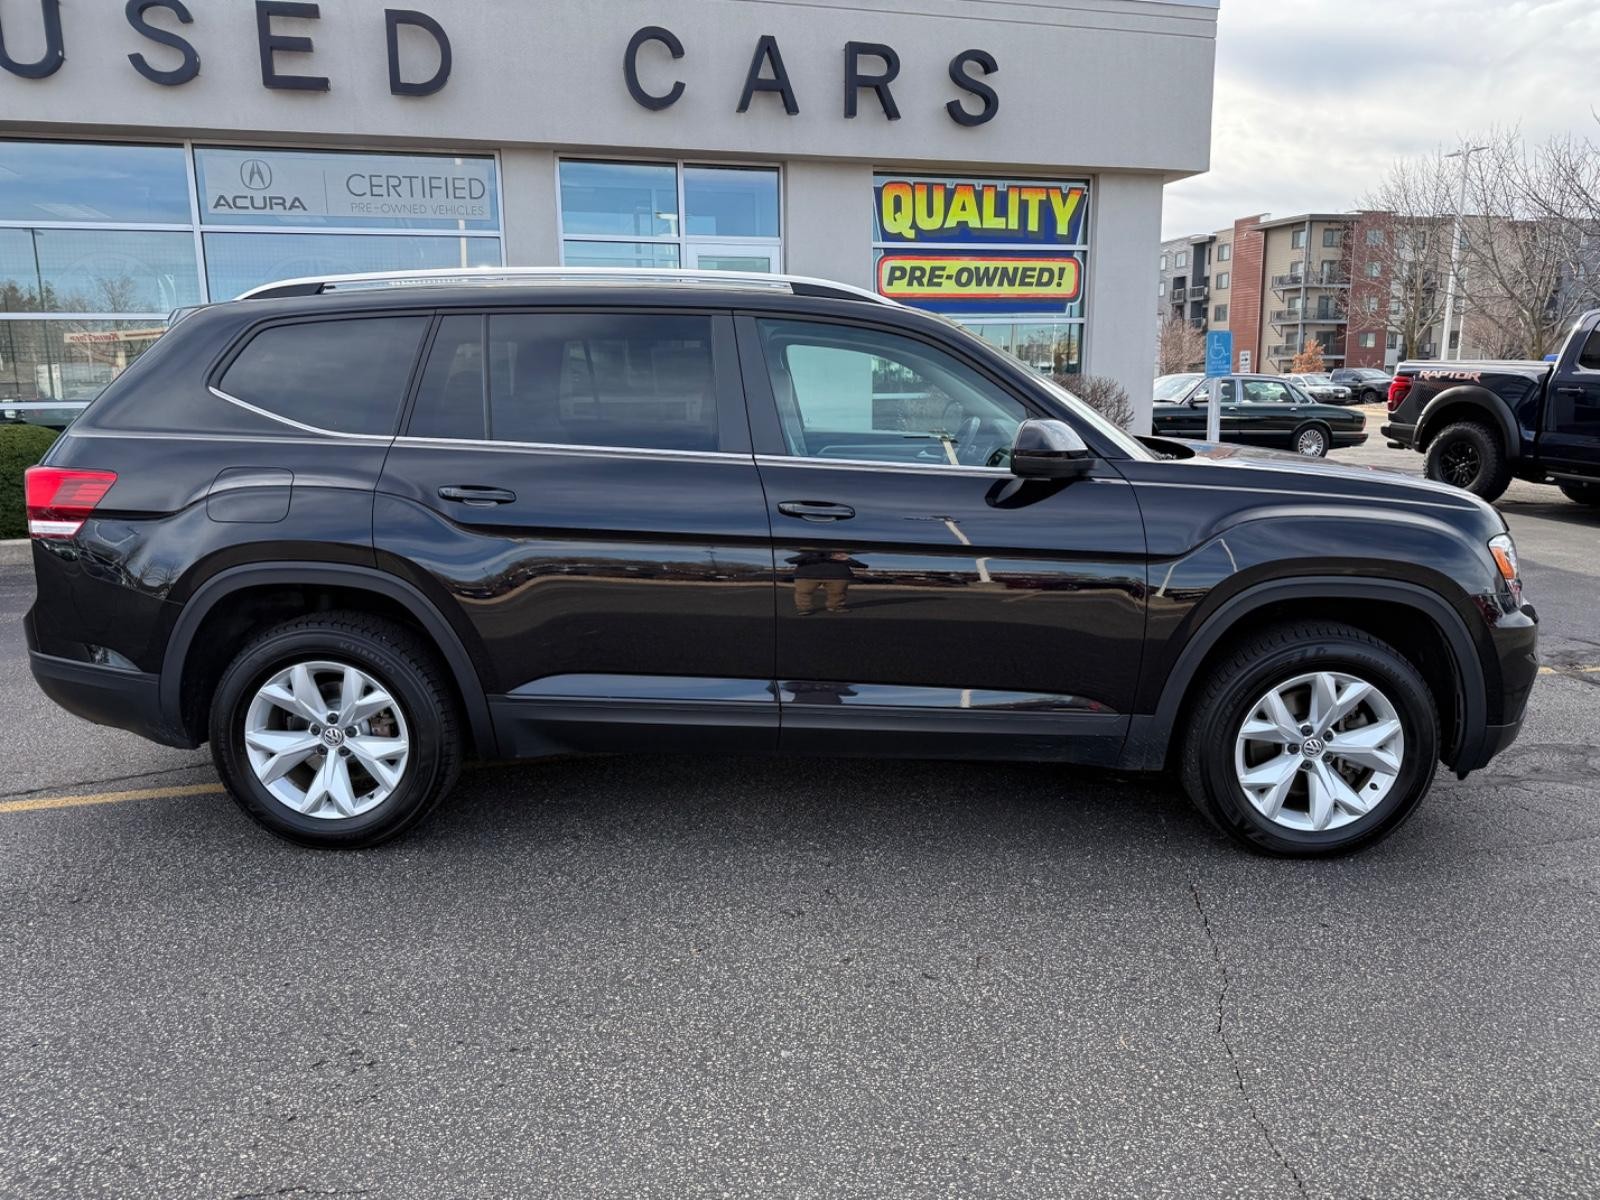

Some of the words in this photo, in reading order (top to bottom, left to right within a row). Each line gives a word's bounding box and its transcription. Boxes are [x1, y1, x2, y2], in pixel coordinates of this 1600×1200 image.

[0, 0, 452, 96] USED
[623, 26, 999, 127] CARS
[346, 173, 486, 200] CERTIFIED
[213, 194, 308, 211] ACURA
[350, 202, 427, 214] PRE-OWNED
[430, 204, 485, 216] VEHICLES
[881, 181, 1085, 240] QUALITY
[886, 265, 1066, 288] PRE-OWNED!
[1419, 369, 1482, 384] RAPTOR
